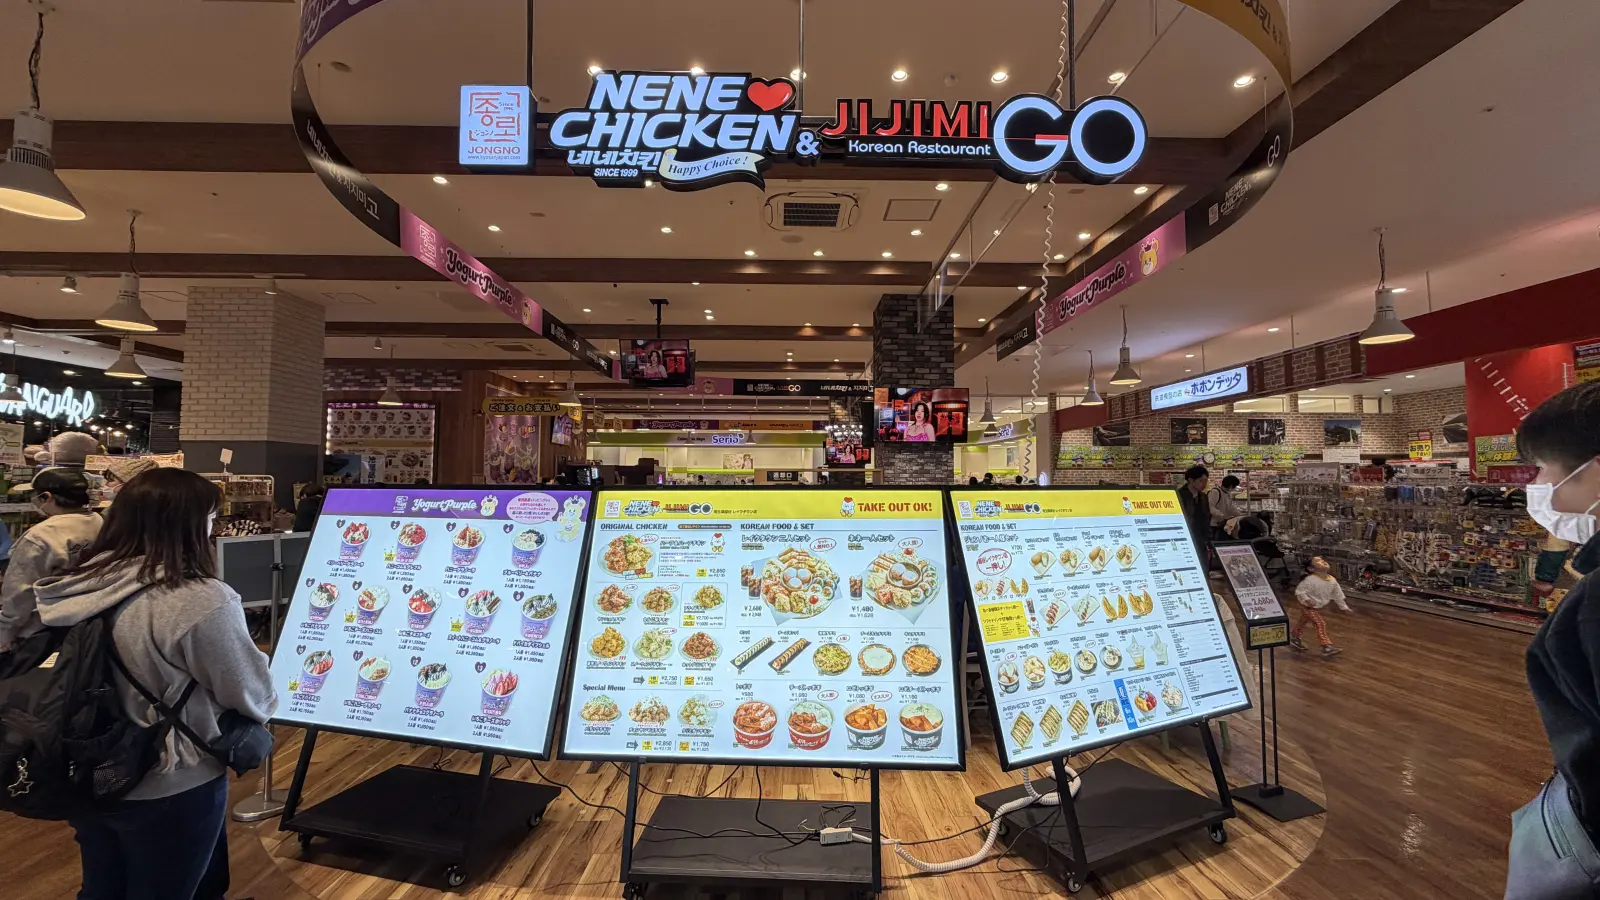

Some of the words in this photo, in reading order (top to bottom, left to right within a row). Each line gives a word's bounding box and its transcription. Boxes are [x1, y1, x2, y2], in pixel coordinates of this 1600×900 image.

[589, 74, 747, 111] NENE
[550, 111, 797, 151] CHICKEN
[796, 131, 819, 156] &
[821, 101, 992, 138] JIJIMI
[993, 96, 1146, 175] GO
[467, 146, 521, 155] JONGNO
[849, 140, 902, 153] Korean
[908, 140, 991, 155] Restaurant
[1267, 134, 1280, 168] GO
[567, 148, 662, 171] 네네치킨
[594, 168, 620, 177] SINCE
[620, 168, 638, 177] 1999
[668, 163, 702, 176] Happy
[704, 157, 741, 171] Choice
[446, 247, 514, 307] YogurtPurple
[1058, 260, 1128, 322] YogurtPurple
[788, 384, 801, 392] GO
[1190, 372, 1242, 396] ポポンデッタ
[712, 433, 741, 445] Seria
[1410, 444, 1431, 453] お売り
[411, 498, 477, 513] YogurtPurple
[623, 505, 660, 513] CHICKEN
[688, 502, 713, 515] GO
[858, 502, 886, 512] TAKE
[888, 502, 910, 512] OUT
[913, 502, 932, 512] OK!
[974, 505, 1002, 513] CHICKEN
[1024, 503, 1041, 514] GO
[1132, 500, 1149, 509] TAKE
[1150, 501, 1162, 509] OUT
[1163, 500, 1174, 509] OK!
[742, 533, 811, 543] レイクタウン二人セット
[582, 684, 606, 692] Special
